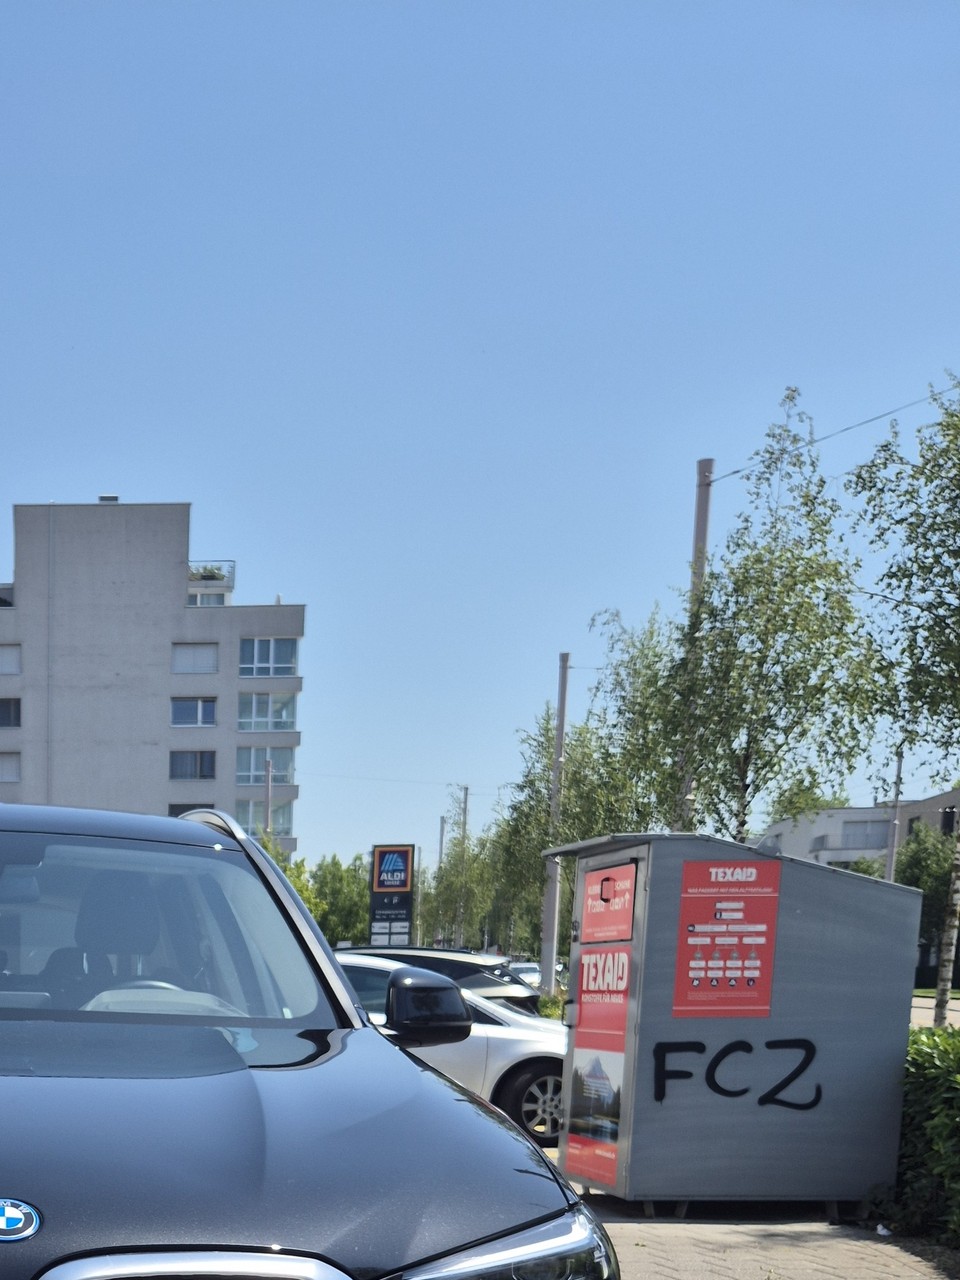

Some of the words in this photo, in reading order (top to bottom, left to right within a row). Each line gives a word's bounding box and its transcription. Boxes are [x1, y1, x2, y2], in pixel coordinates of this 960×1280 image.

[380, 872, 405, 880] ALDI
[709, 867, 757, 882] TEXAID
[581, 952, 628, 991] TEXAID
